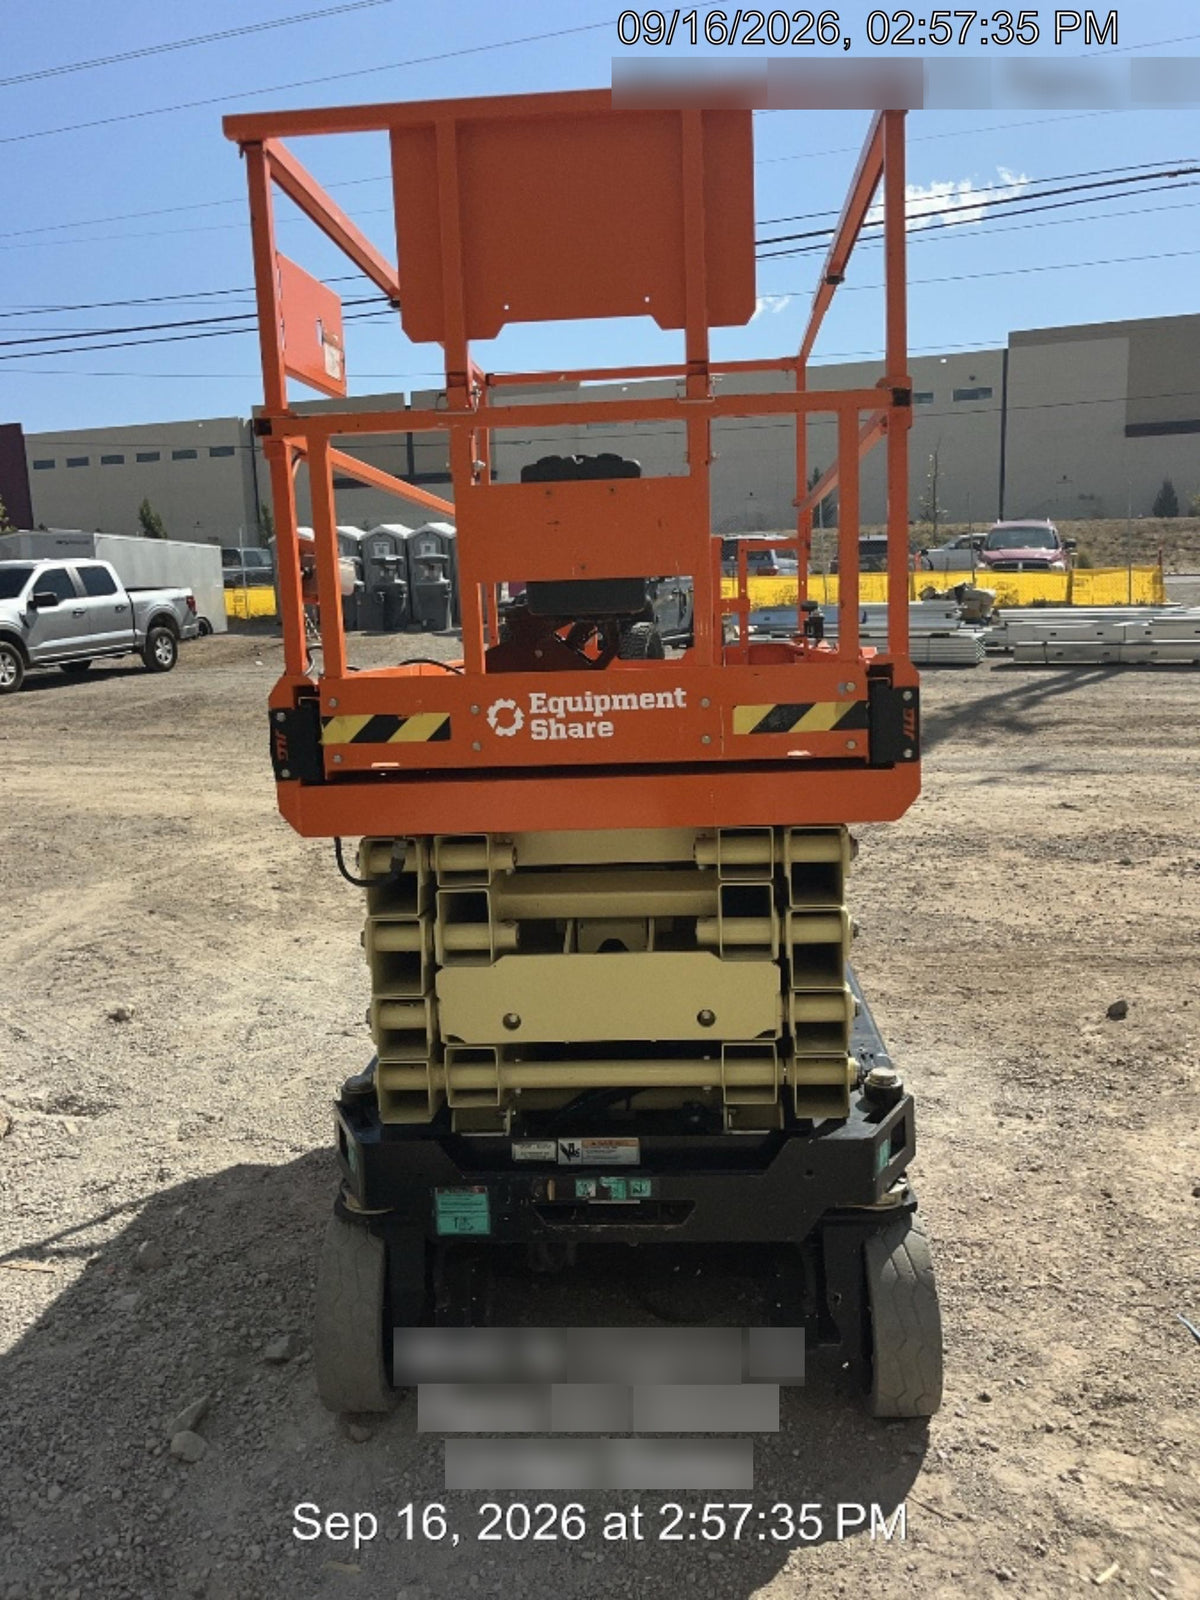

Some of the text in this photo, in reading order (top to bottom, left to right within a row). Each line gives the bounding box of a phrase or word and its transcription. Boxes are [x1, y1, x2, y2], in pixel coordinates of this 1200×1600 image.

[529, 687, 687, 718] Equipment
[530, 718, 614, 741] Share
[902, 708, 915, 741] JLG
